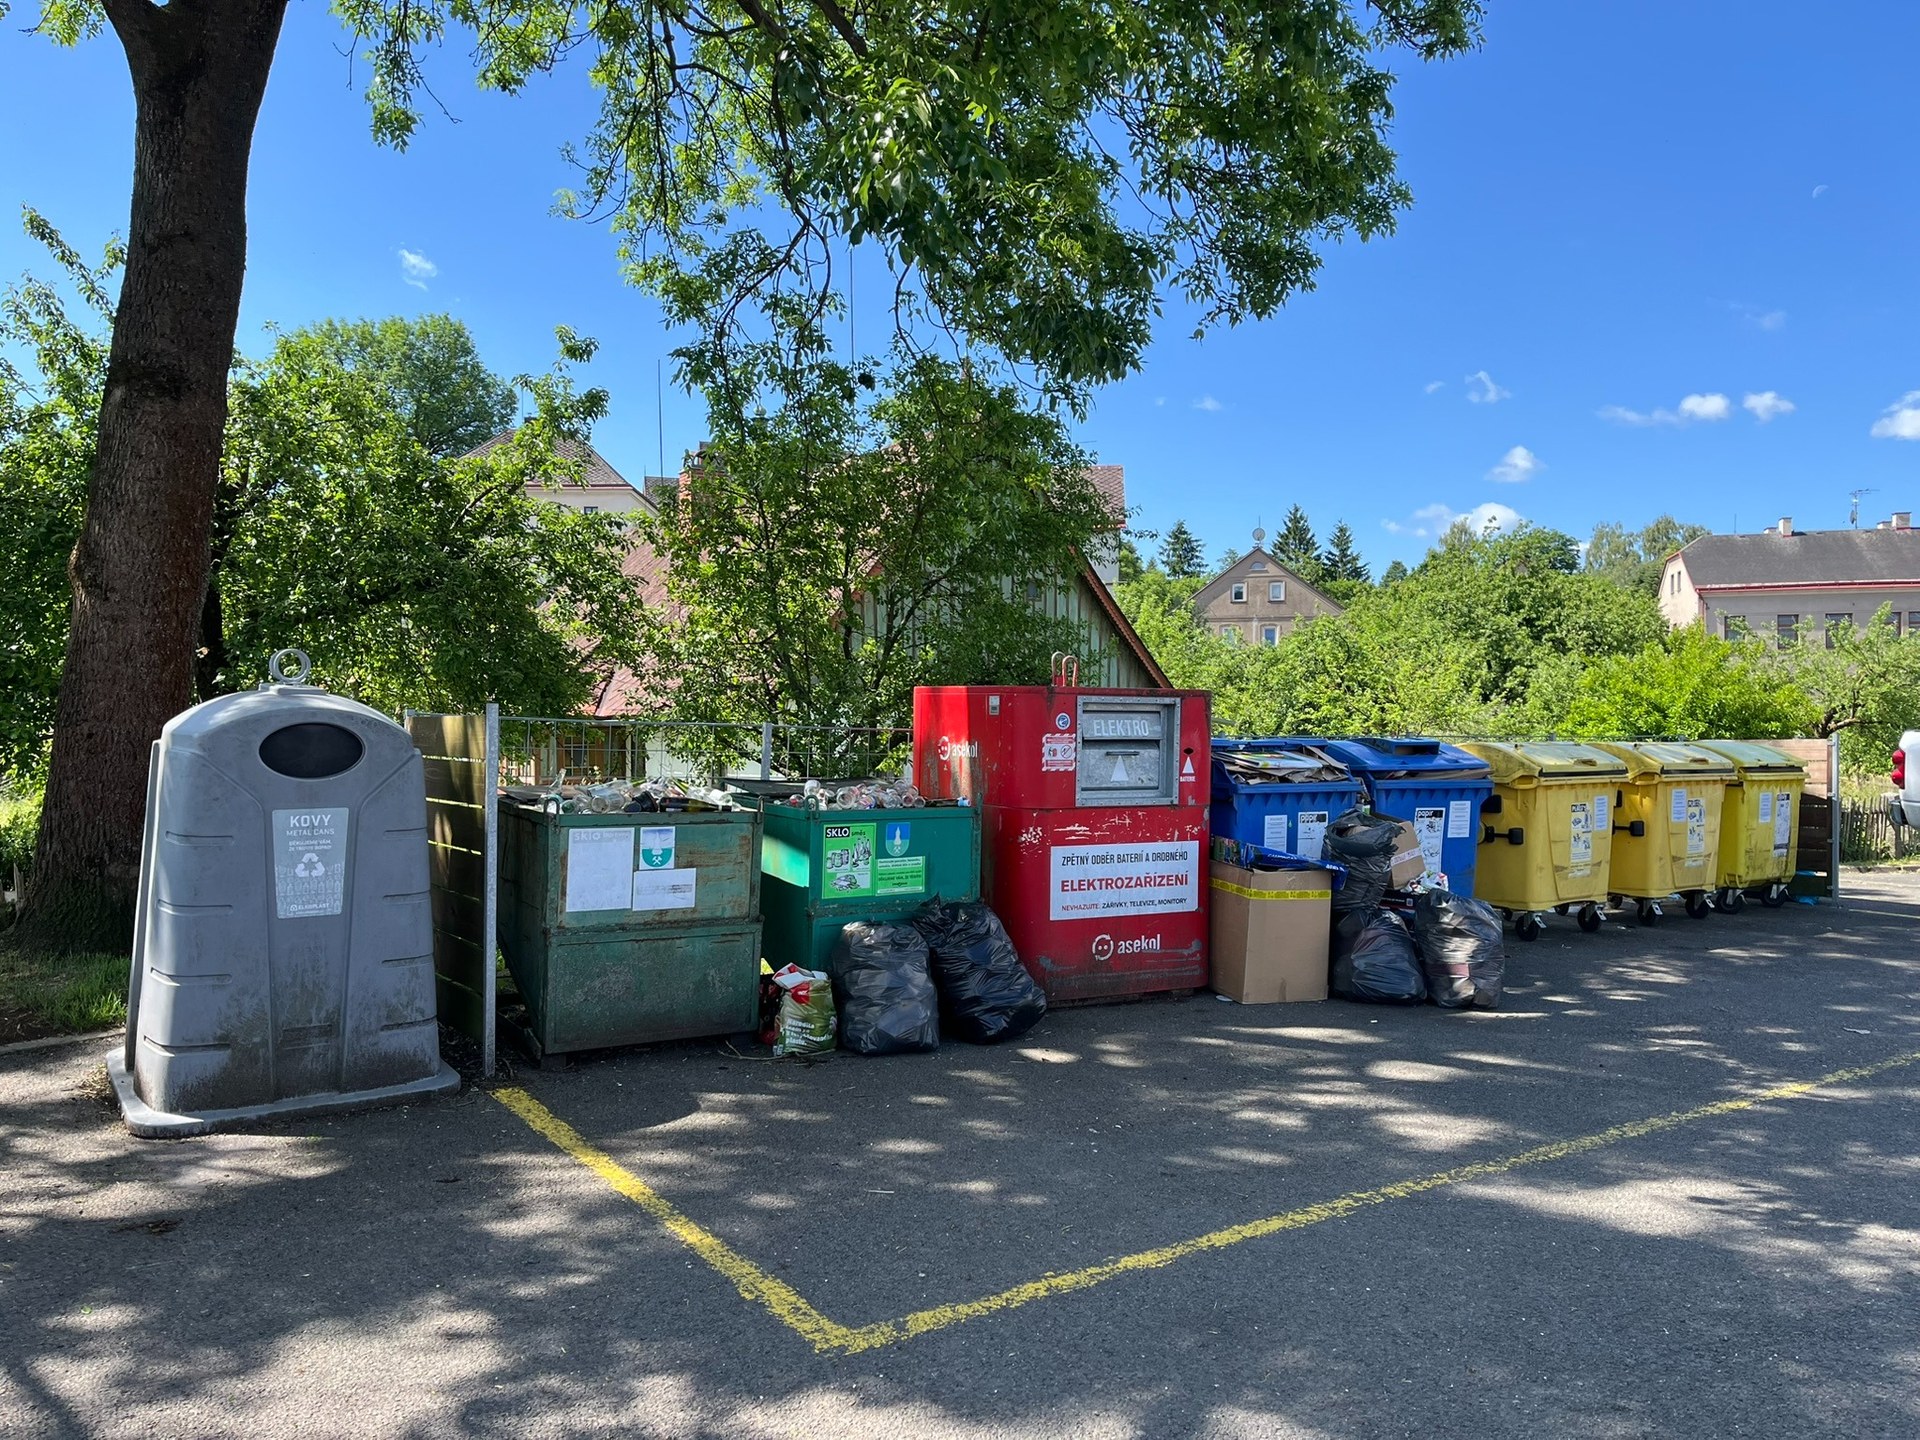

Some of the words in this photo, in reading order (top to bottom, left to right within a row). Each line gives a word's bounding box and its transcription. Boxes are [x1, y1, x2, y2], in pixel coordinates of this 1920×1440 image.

[1093, 719, 1149, 736] ELEKTRO
[952, 741, 978, 758] asekol
[290, 814, 331, 827] KOVY
[313, 828, 335, 836] CANS
[826, 828, 850, 837] SKLO
[1061, 852, 1090, 866] ZPĚTNÝ
[1091, 851, 1115, 865] ODBĚR
[1117, 850, 1144, 864] BATERIÍ
[1145, 853, 1150, 862] A
[1152, 849, 1188, 862] DROBNÉHO
[1061, 870, 1188, 892] ELEKTROZAŘÍZENÍ
[1117, 933, 1161, 954] asekol
